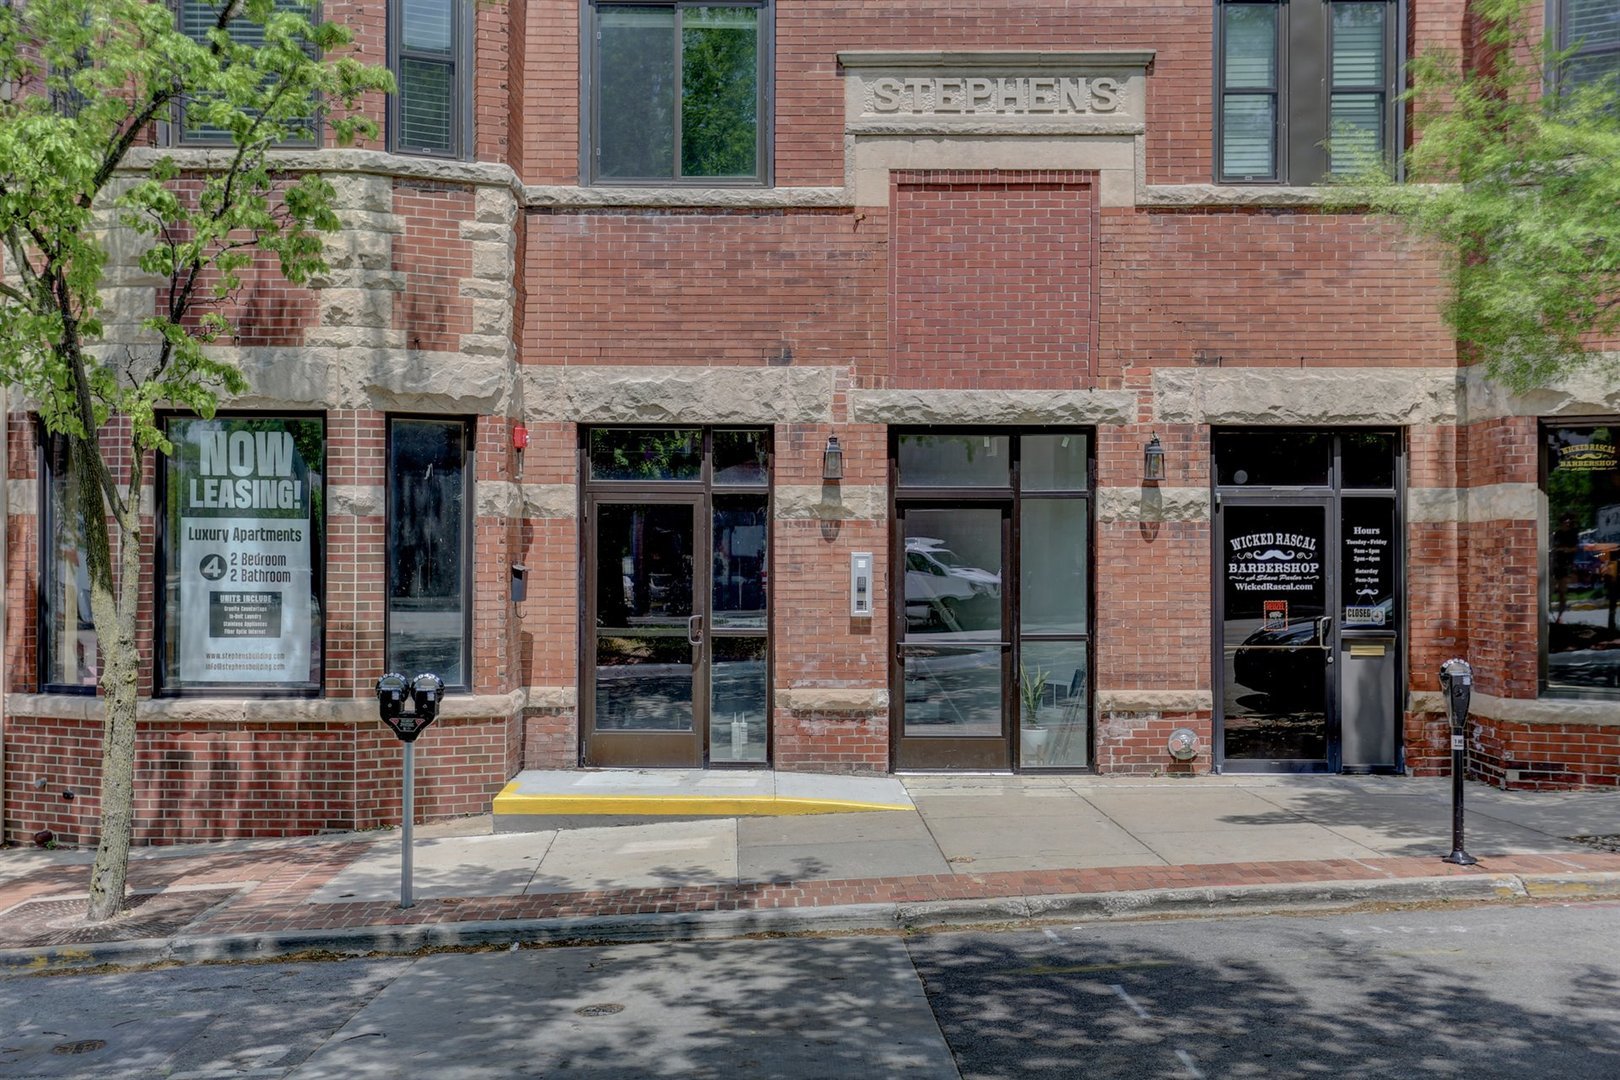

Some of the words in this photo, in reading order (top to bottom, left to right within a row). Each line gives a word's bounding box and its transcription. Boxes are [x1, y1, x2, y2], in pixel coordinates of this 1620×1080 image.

[873, 77, 1119, 113] STEPHENS
[200, 430, 294, 477] NOW
[189, 479, 302, 509] LEASING!
[188, 526, 229, 543] Luxury
[233, 527, 302, 543] Apartments
[1353, 526, 1380, 535] Hours
[1230, 533, 1274, 551] WICKED
[1275, 533, 1316, 551] RASCAL
[202, 556, 222, 578] 4
[230, 552, 238, 565] 2
[241, 553, 287, 566] Bedroom
[230, 569, 238, 582] 2
[241, 569, 291, 582] Bathroom
[1228, 563, 1320, 573] BARBERSHOP
[1235, 583, 1313, 591] WickedRascal.com
